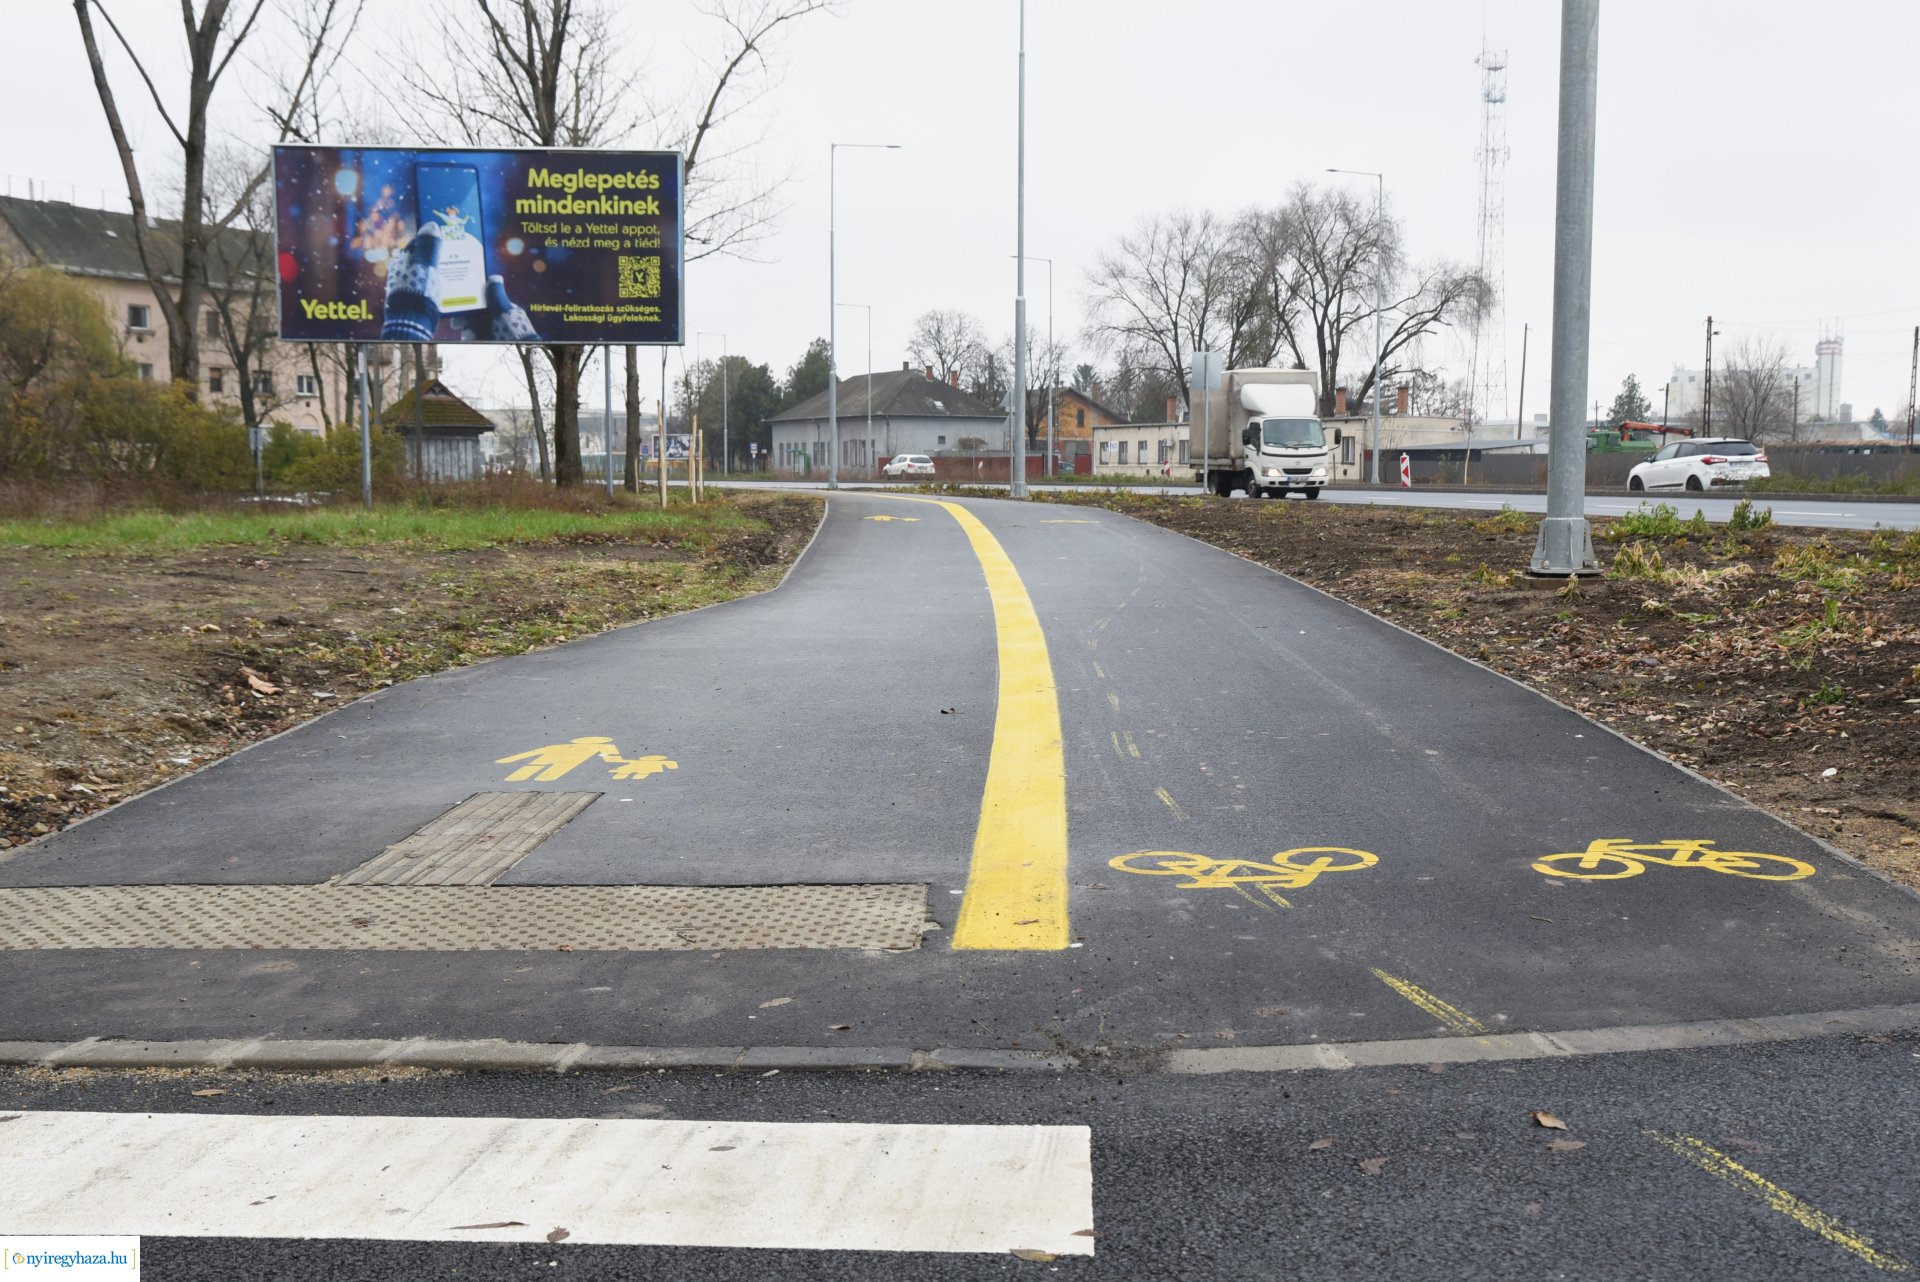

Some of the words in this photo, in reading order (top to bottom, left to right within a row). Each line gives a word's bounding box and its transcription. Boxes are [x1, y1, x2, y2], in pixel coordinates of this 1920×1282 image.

[528, 168, 660, 193] Meglepetés
[516, 194, 660, 215] mindenkinek
[520, 221, 557, 234] Töltsd
[560, 222, 571, 234] le
[575, 225, 582, 234] a
[586, 222, 618, 235] Yettel
[622, 224, 660, 237] appot,
[544, 236, 558, 248] és
[562, 237, 590, 248] nézd
[594, 239, 620, 251] meg
[624, 239, 631, 248] a
[634, 237, 660, 248] tiéd!
[300, 298, 374, 320] Yettel.
[616, 304, 661, 314] szükséges.
[563, 313, 605, 323] Lakossági
